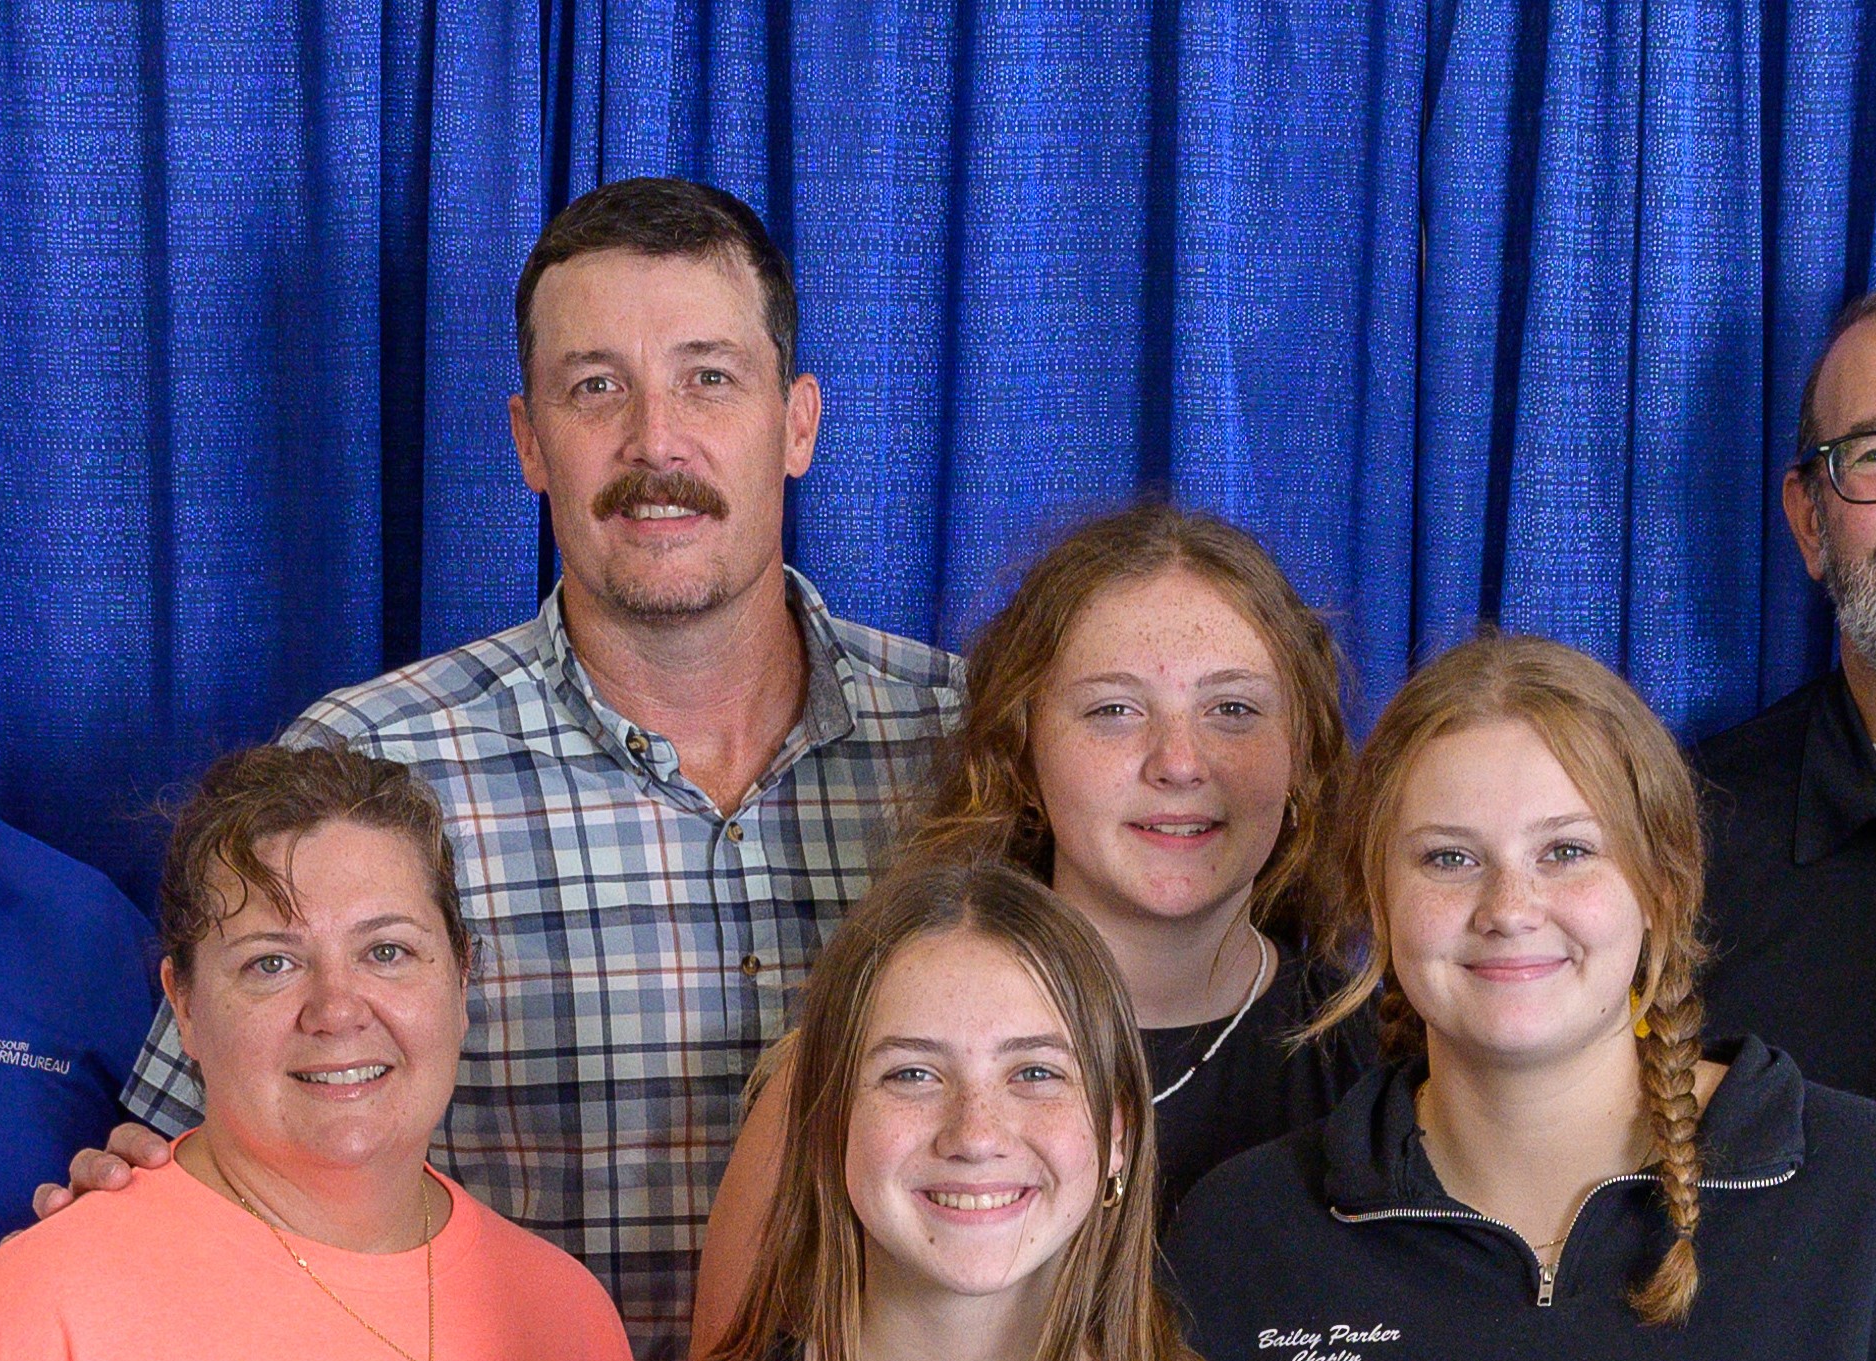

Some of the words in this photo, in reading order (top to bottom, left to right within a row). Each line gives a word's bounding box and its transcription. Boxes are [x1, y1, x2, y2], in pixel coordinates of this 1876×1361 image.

[21, 1053, 70, 1075] BUREAU
[1258, 1327, 1322, 1349] Bailey
[1328, 1323, 1401, 1346] Parker
